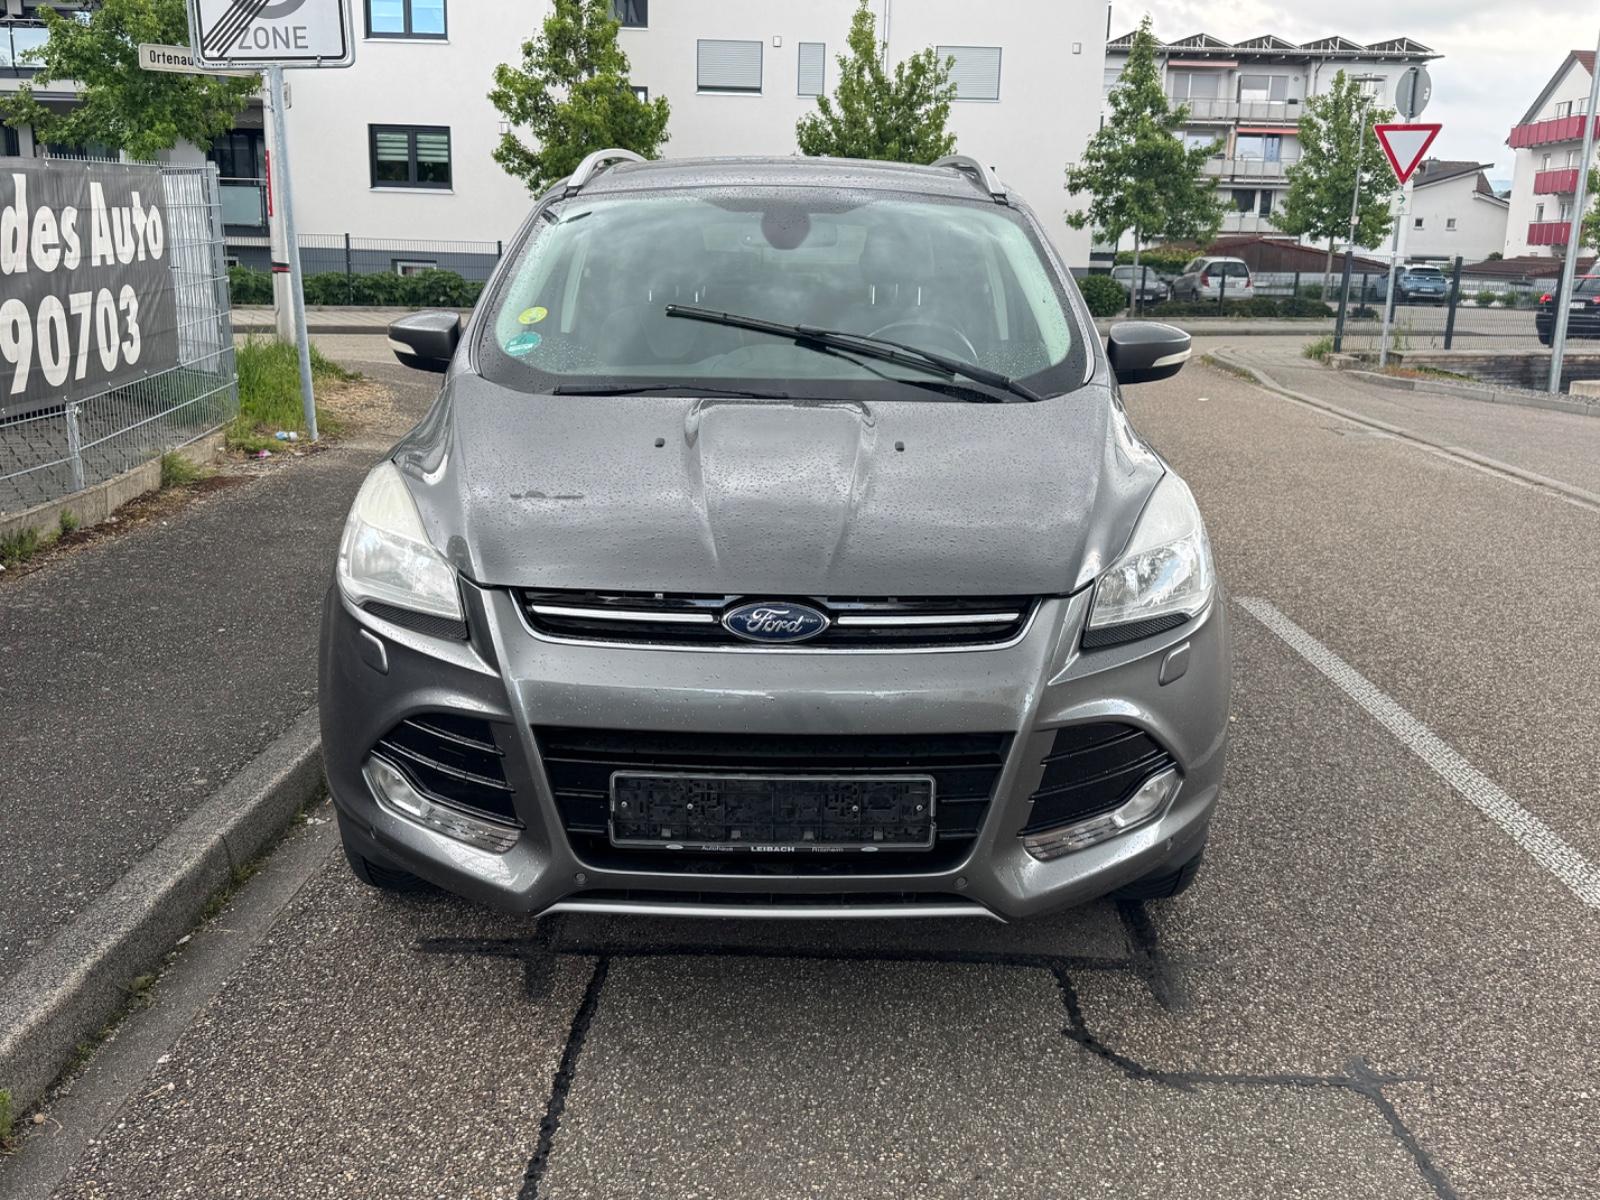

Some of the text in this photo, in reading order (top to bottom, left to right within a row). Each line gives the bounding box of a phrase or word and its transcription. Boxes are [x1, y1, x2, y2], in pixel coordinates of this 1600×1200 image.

[238, 26, 309, 50] ZONE
[0, 173, 81, 276] des
[90, 181, 164, 267] Auto
[0, 284, 141, 395] 90703
[746, 607, 804, 633] Ford
